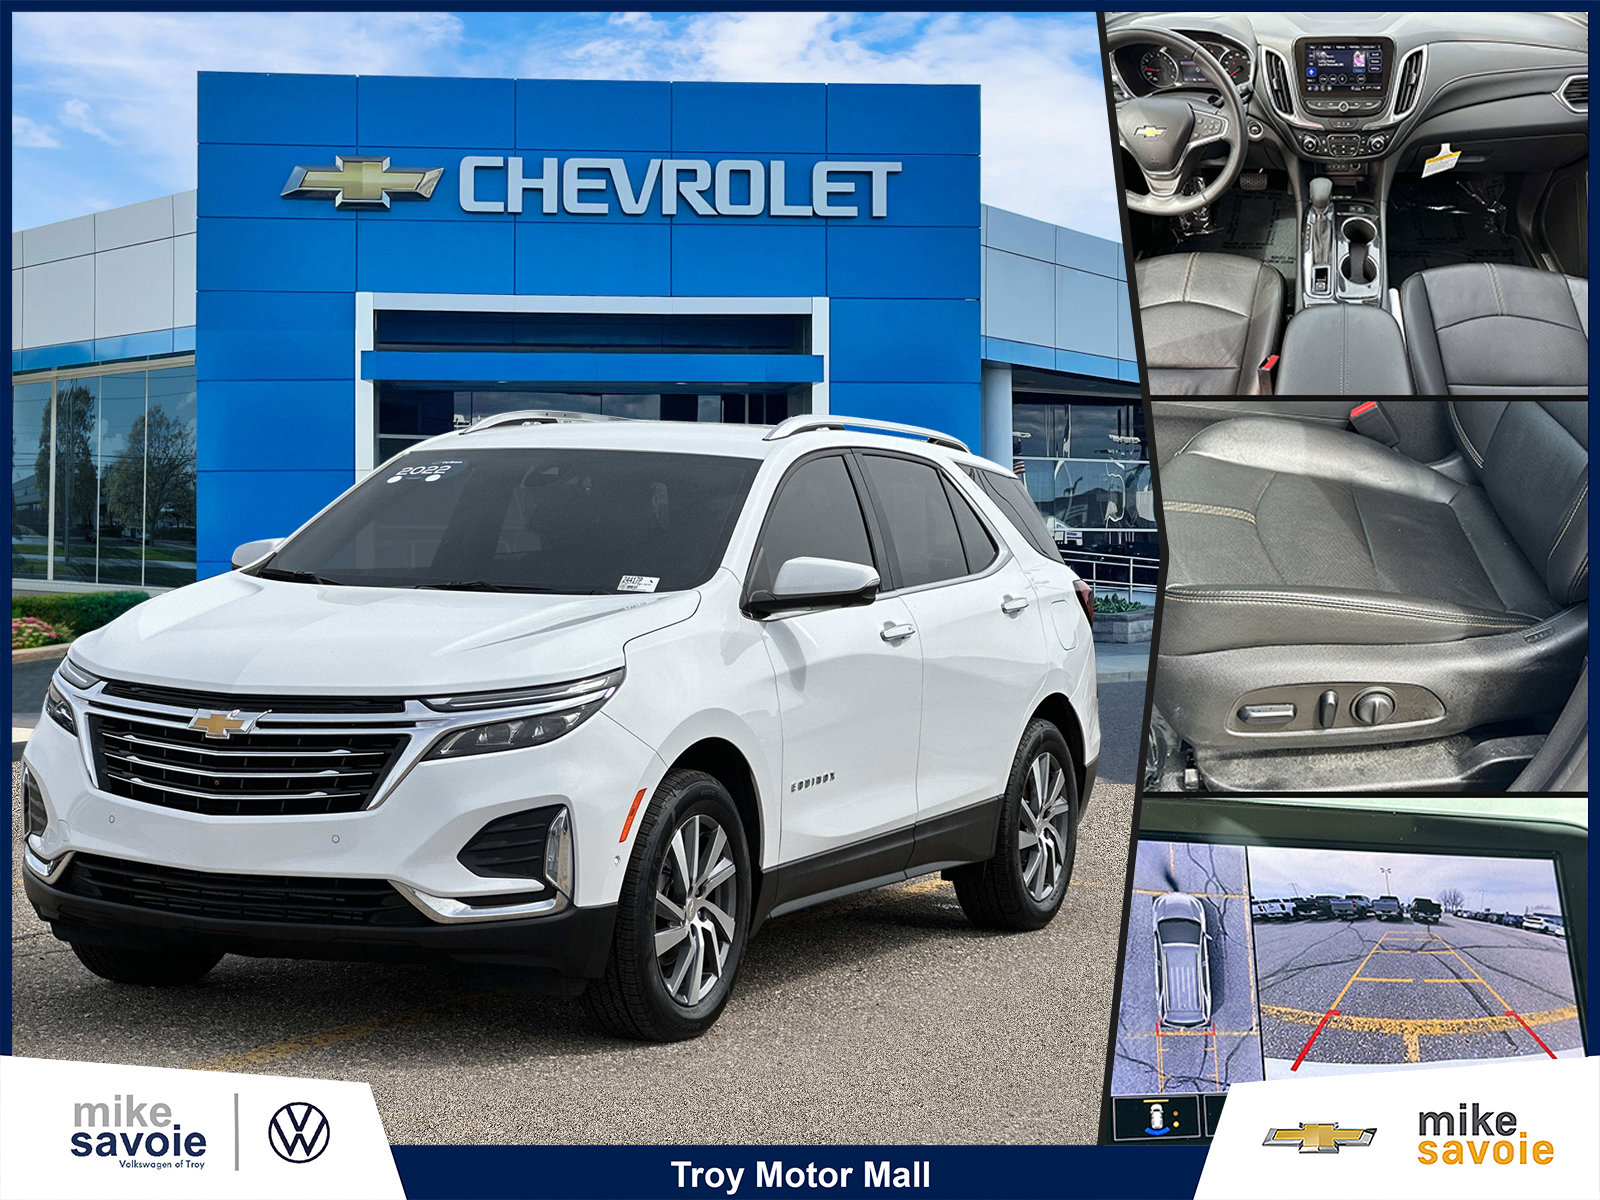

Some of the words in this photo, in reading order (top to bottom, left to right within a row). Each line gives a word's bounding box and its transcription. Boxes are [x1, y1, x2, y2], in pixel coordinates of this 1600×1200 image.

[459, 156, 902, 217] CHEVROLET
[395, 464, 452, 476] 2022
[790, 771, 836, 793] EQUINOX
